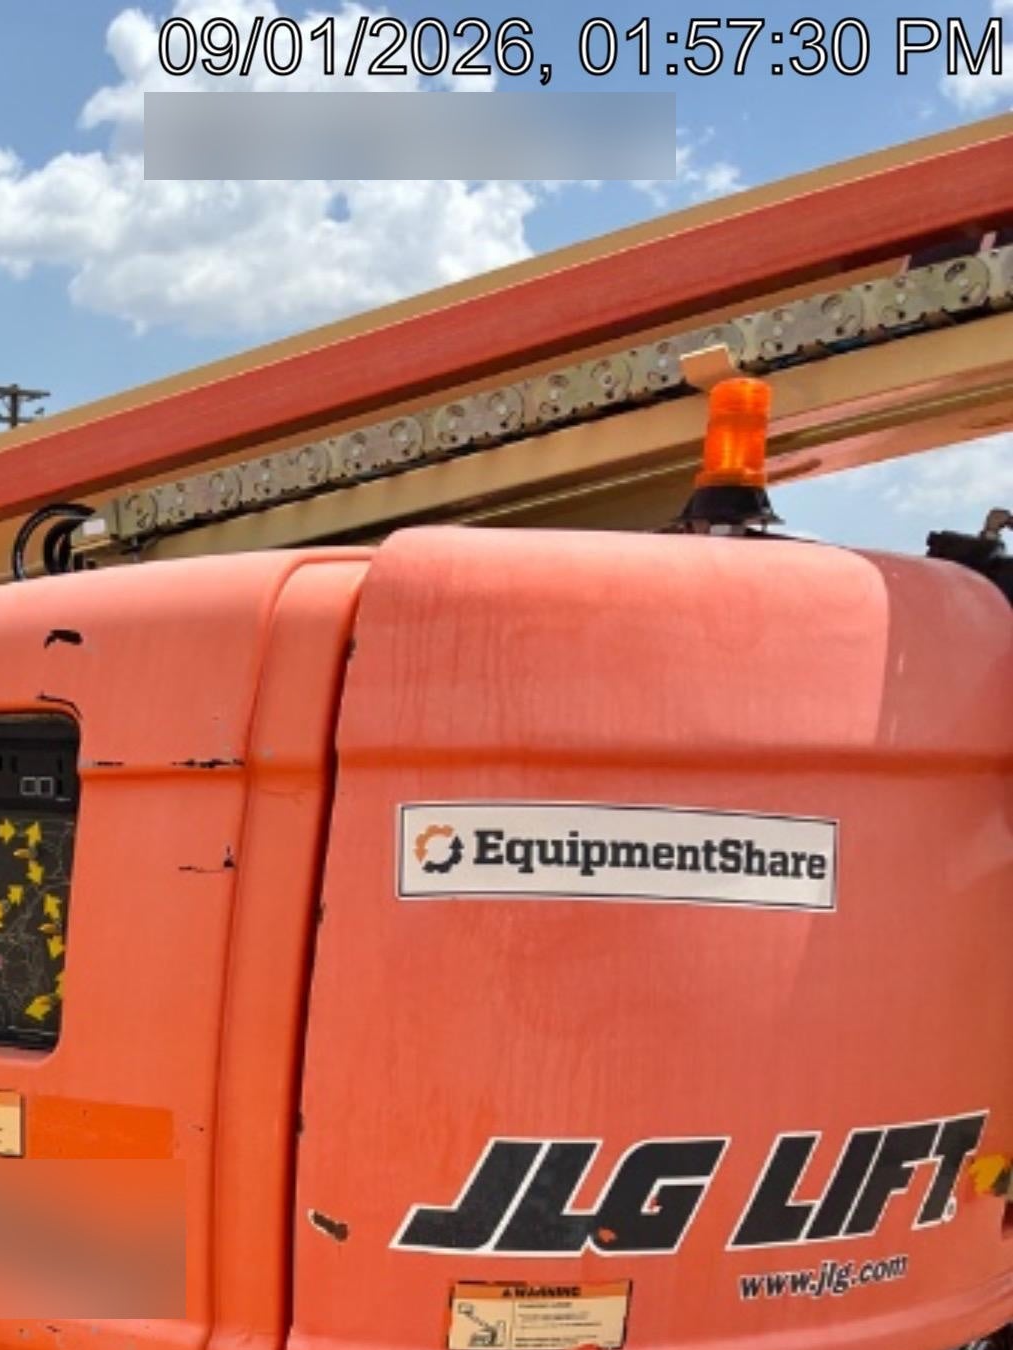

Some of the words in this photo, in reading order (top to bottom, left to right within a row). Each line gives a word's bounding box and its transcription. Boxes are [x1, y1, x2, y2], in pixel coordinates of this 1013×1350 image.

[472, 829, 827, 881] EquipmentShare
[389, 1137, 731, 1257] JLG
[726, 1109, 989, 1251] LIFT
[740, 1255, 908, 1300] www.jlg.com
